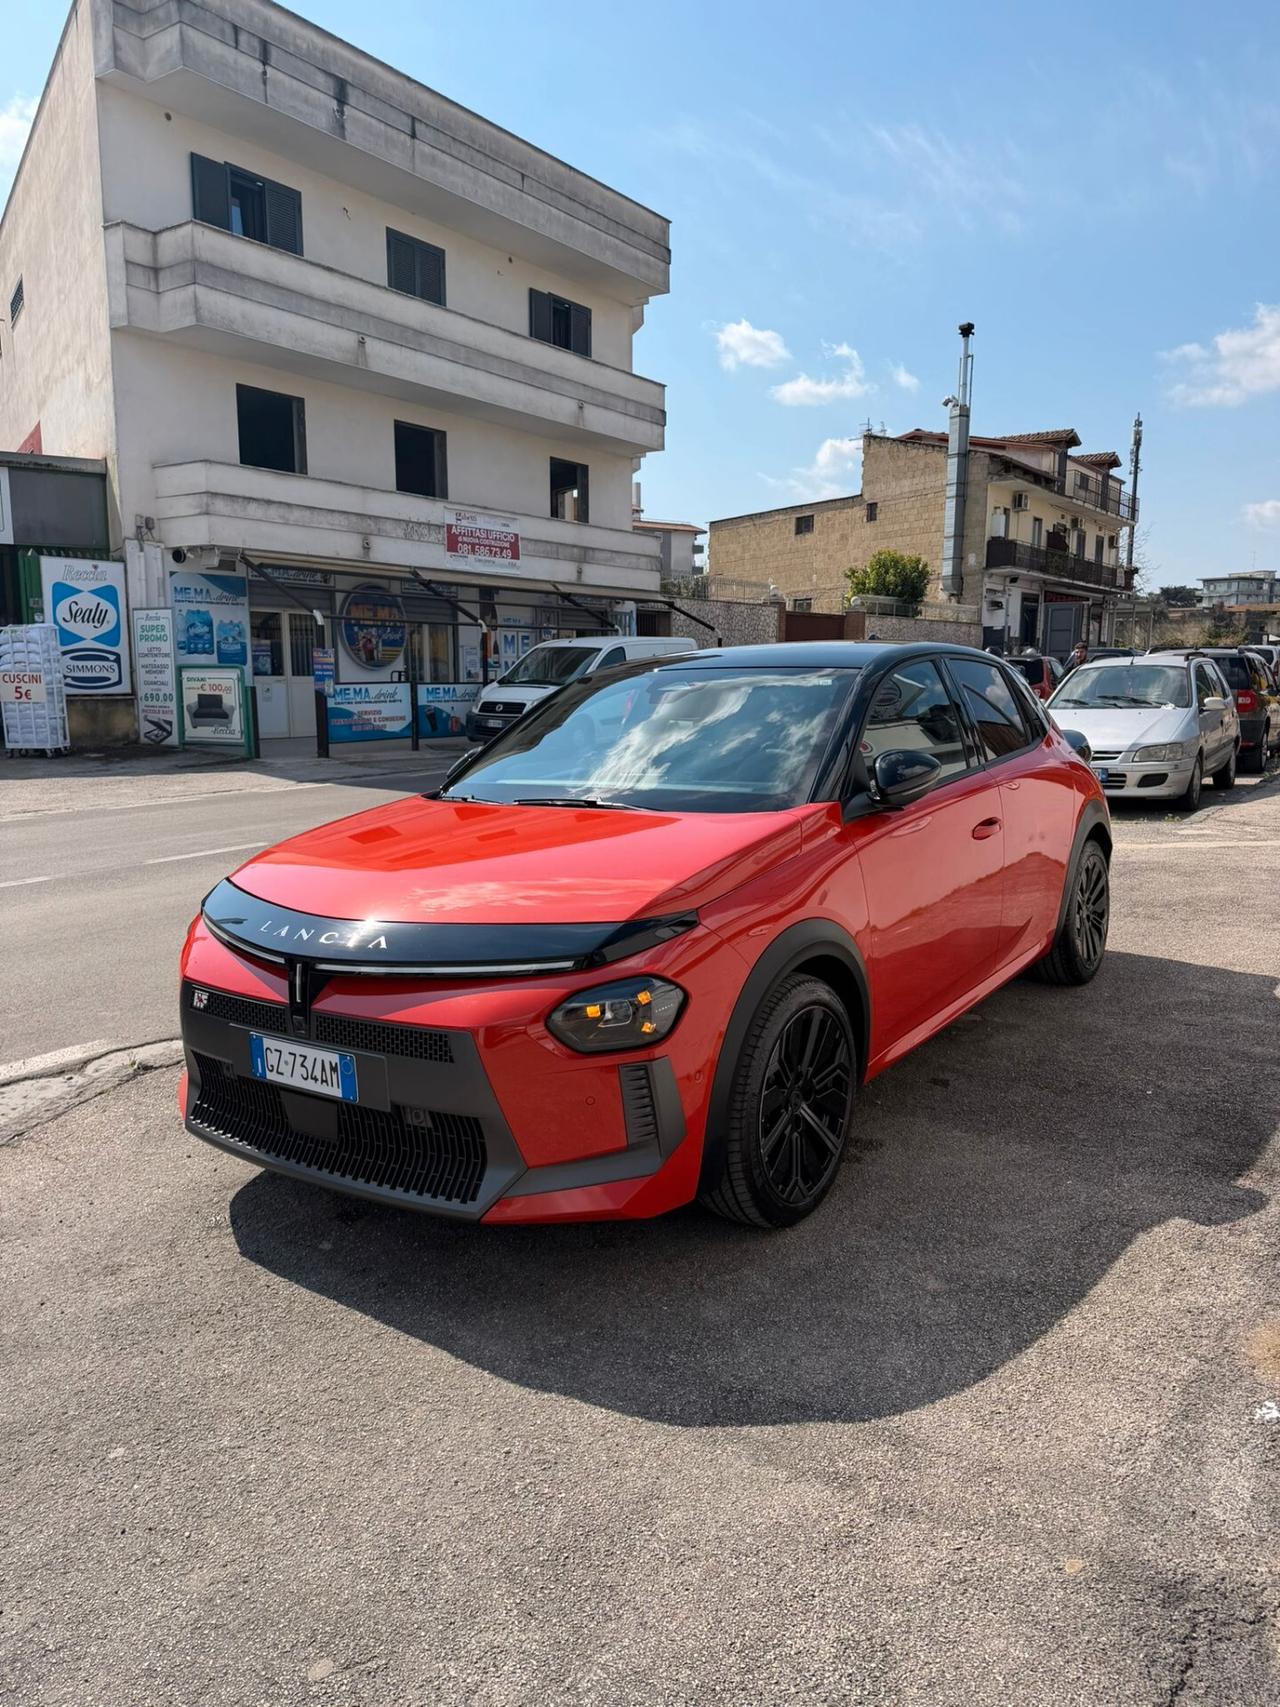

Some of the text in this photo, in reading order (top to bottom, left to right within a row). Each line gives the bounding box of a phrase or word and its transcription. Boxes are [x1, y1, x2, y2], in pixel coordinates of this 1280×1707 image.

[451, 526, 514, 542] AFFITTASI UFFICIO
[62, 601, 108, 629] Sealy
[140, 625, 166, 633] SUPER
[66, 664, 115, 673] SIMMONS
[2, 674, 41, 684] CUSCINI
